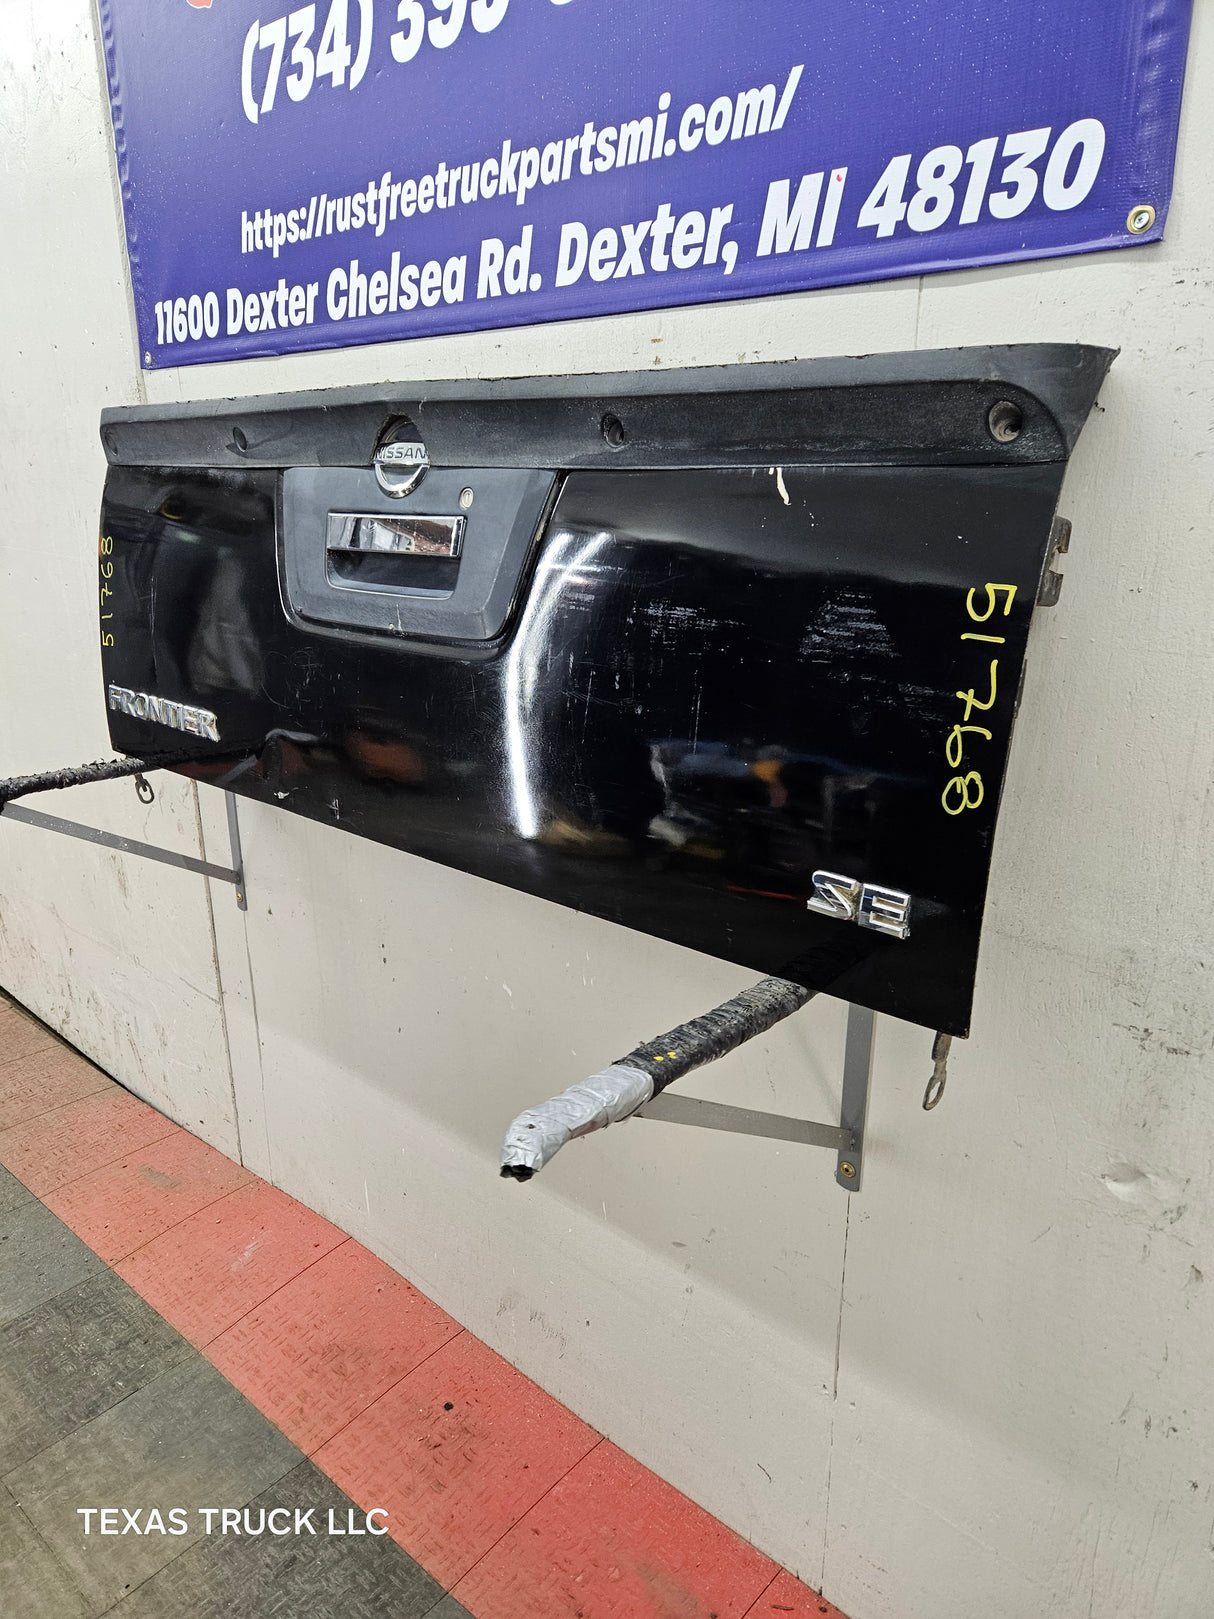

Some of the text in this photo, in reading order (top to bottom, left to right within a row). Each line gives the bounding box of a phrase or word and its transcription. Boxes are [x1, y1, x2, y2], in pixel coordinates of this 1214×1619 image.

[242, 0, 373, 124] (734)
[242, 65, 804, 258] https://rustfreetruckpartsmi.com/
[154, 118, 1106, 345] 11600 Dexter Chelsea Rd. Dexter, MI 48130
[374, 446, 427, 460] NISSAN
[100, 535, 115, 647] 51768
[108, 683, 222, 743] FRONTIER
[941, 582, 1018, 816] 51768
[807, 869, 912, 940] SE
